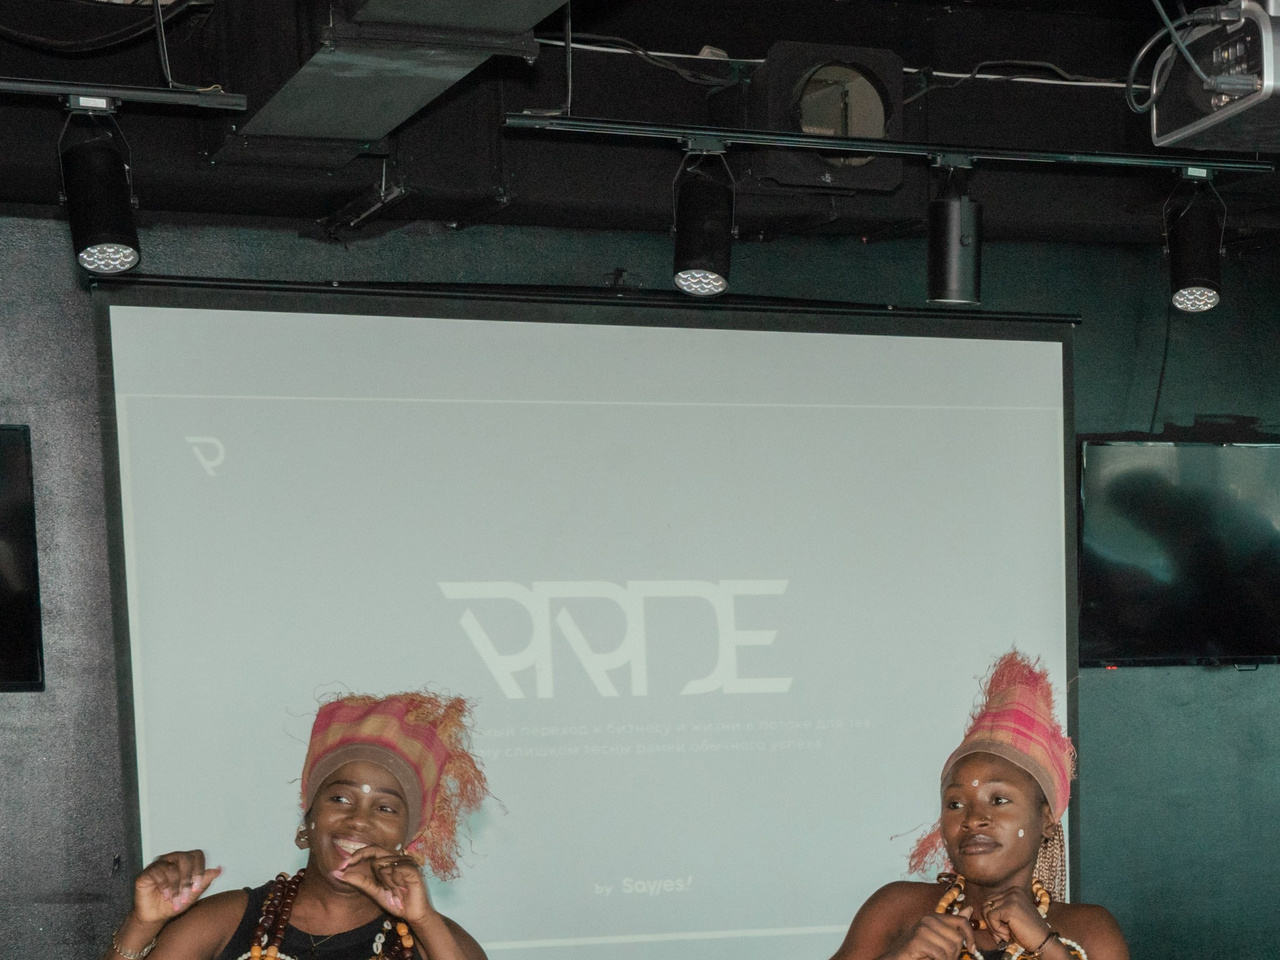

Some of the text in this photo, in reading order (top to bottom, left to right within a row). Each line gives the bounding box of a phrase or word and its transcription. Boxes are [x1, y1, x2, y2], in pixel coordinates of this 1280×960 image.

[520, 725, 588, 738] переход
[606, 721, 672, 736] бизнесу
[691, 721, 741, 732] жизни
[759, 720, 813, 731] потоке
[504, 746, 579, 758] слишком
[584, 744, 631, 755] тесны
[635, 743, 686, 756] рамки
[690, 739, 766, 752] обычного
[770, 739, 822, 753] успеха
[594, 883, 613, 897] by
